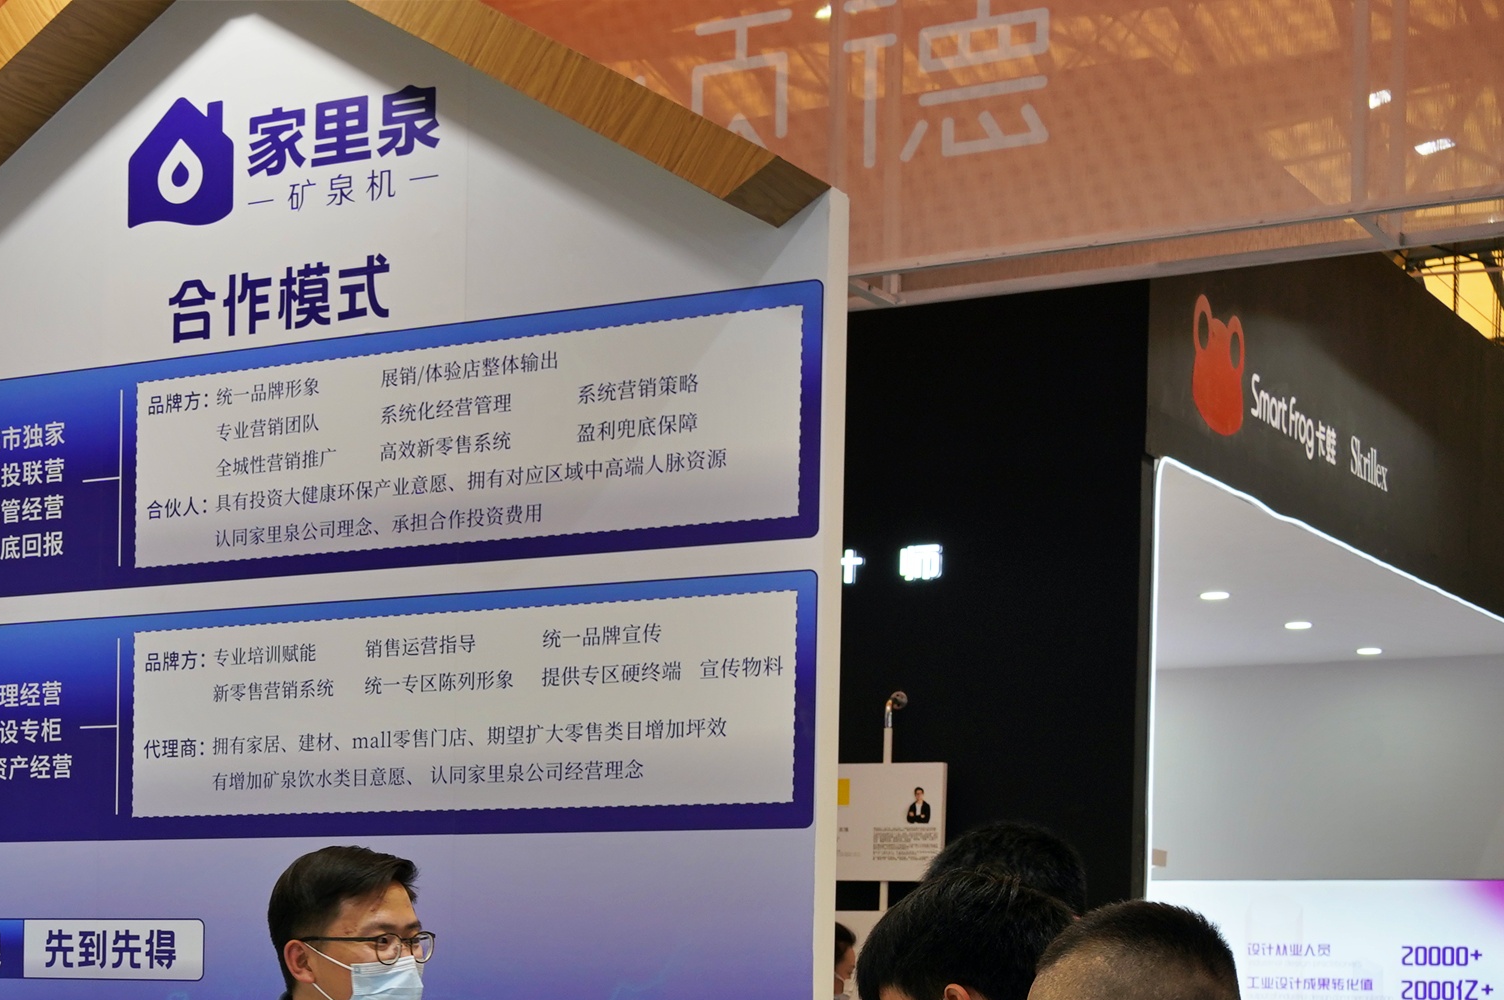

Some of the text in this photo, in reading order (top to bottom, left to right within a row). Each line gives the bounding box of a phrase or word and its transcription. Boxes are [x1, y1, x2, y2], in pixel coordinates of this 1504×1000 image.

[247, 84, 441, 177] 家里泉
[168, 253, 390, 344] 合作模式
[216, 377, 320, 406] 统一品牌形象
[380, 351, 559, 388] 展销/体验店整体输出
[577, 373, 699, 406] 系统营销策略
[216, 394, 699, 444] 专业营销团队 系统化经营管理 盈利兜底保障
[1250, 372, 1287, 435] Smart
[216, 431, 512, 478] 全城性营销推广 高效新零售系统
[1350, 435, 1388, 492] Skrillex
[213, 643, 316, 668] 专业培训赋能
[366, 634, 476, 659] 销售运营指导
[542, 622, 662, 650] 统一品牌宣传
[212, 655, 784, 703] 新零售营销系统 统一专区陈列形象 提供专区硬终端 宣传物料
[45, 929, 177, 970] 先到先得
[1248, 942, 1483, 967] 设计从业人员 20000+
[1247, 976, 1374, 992] 工业设计成果转化值
